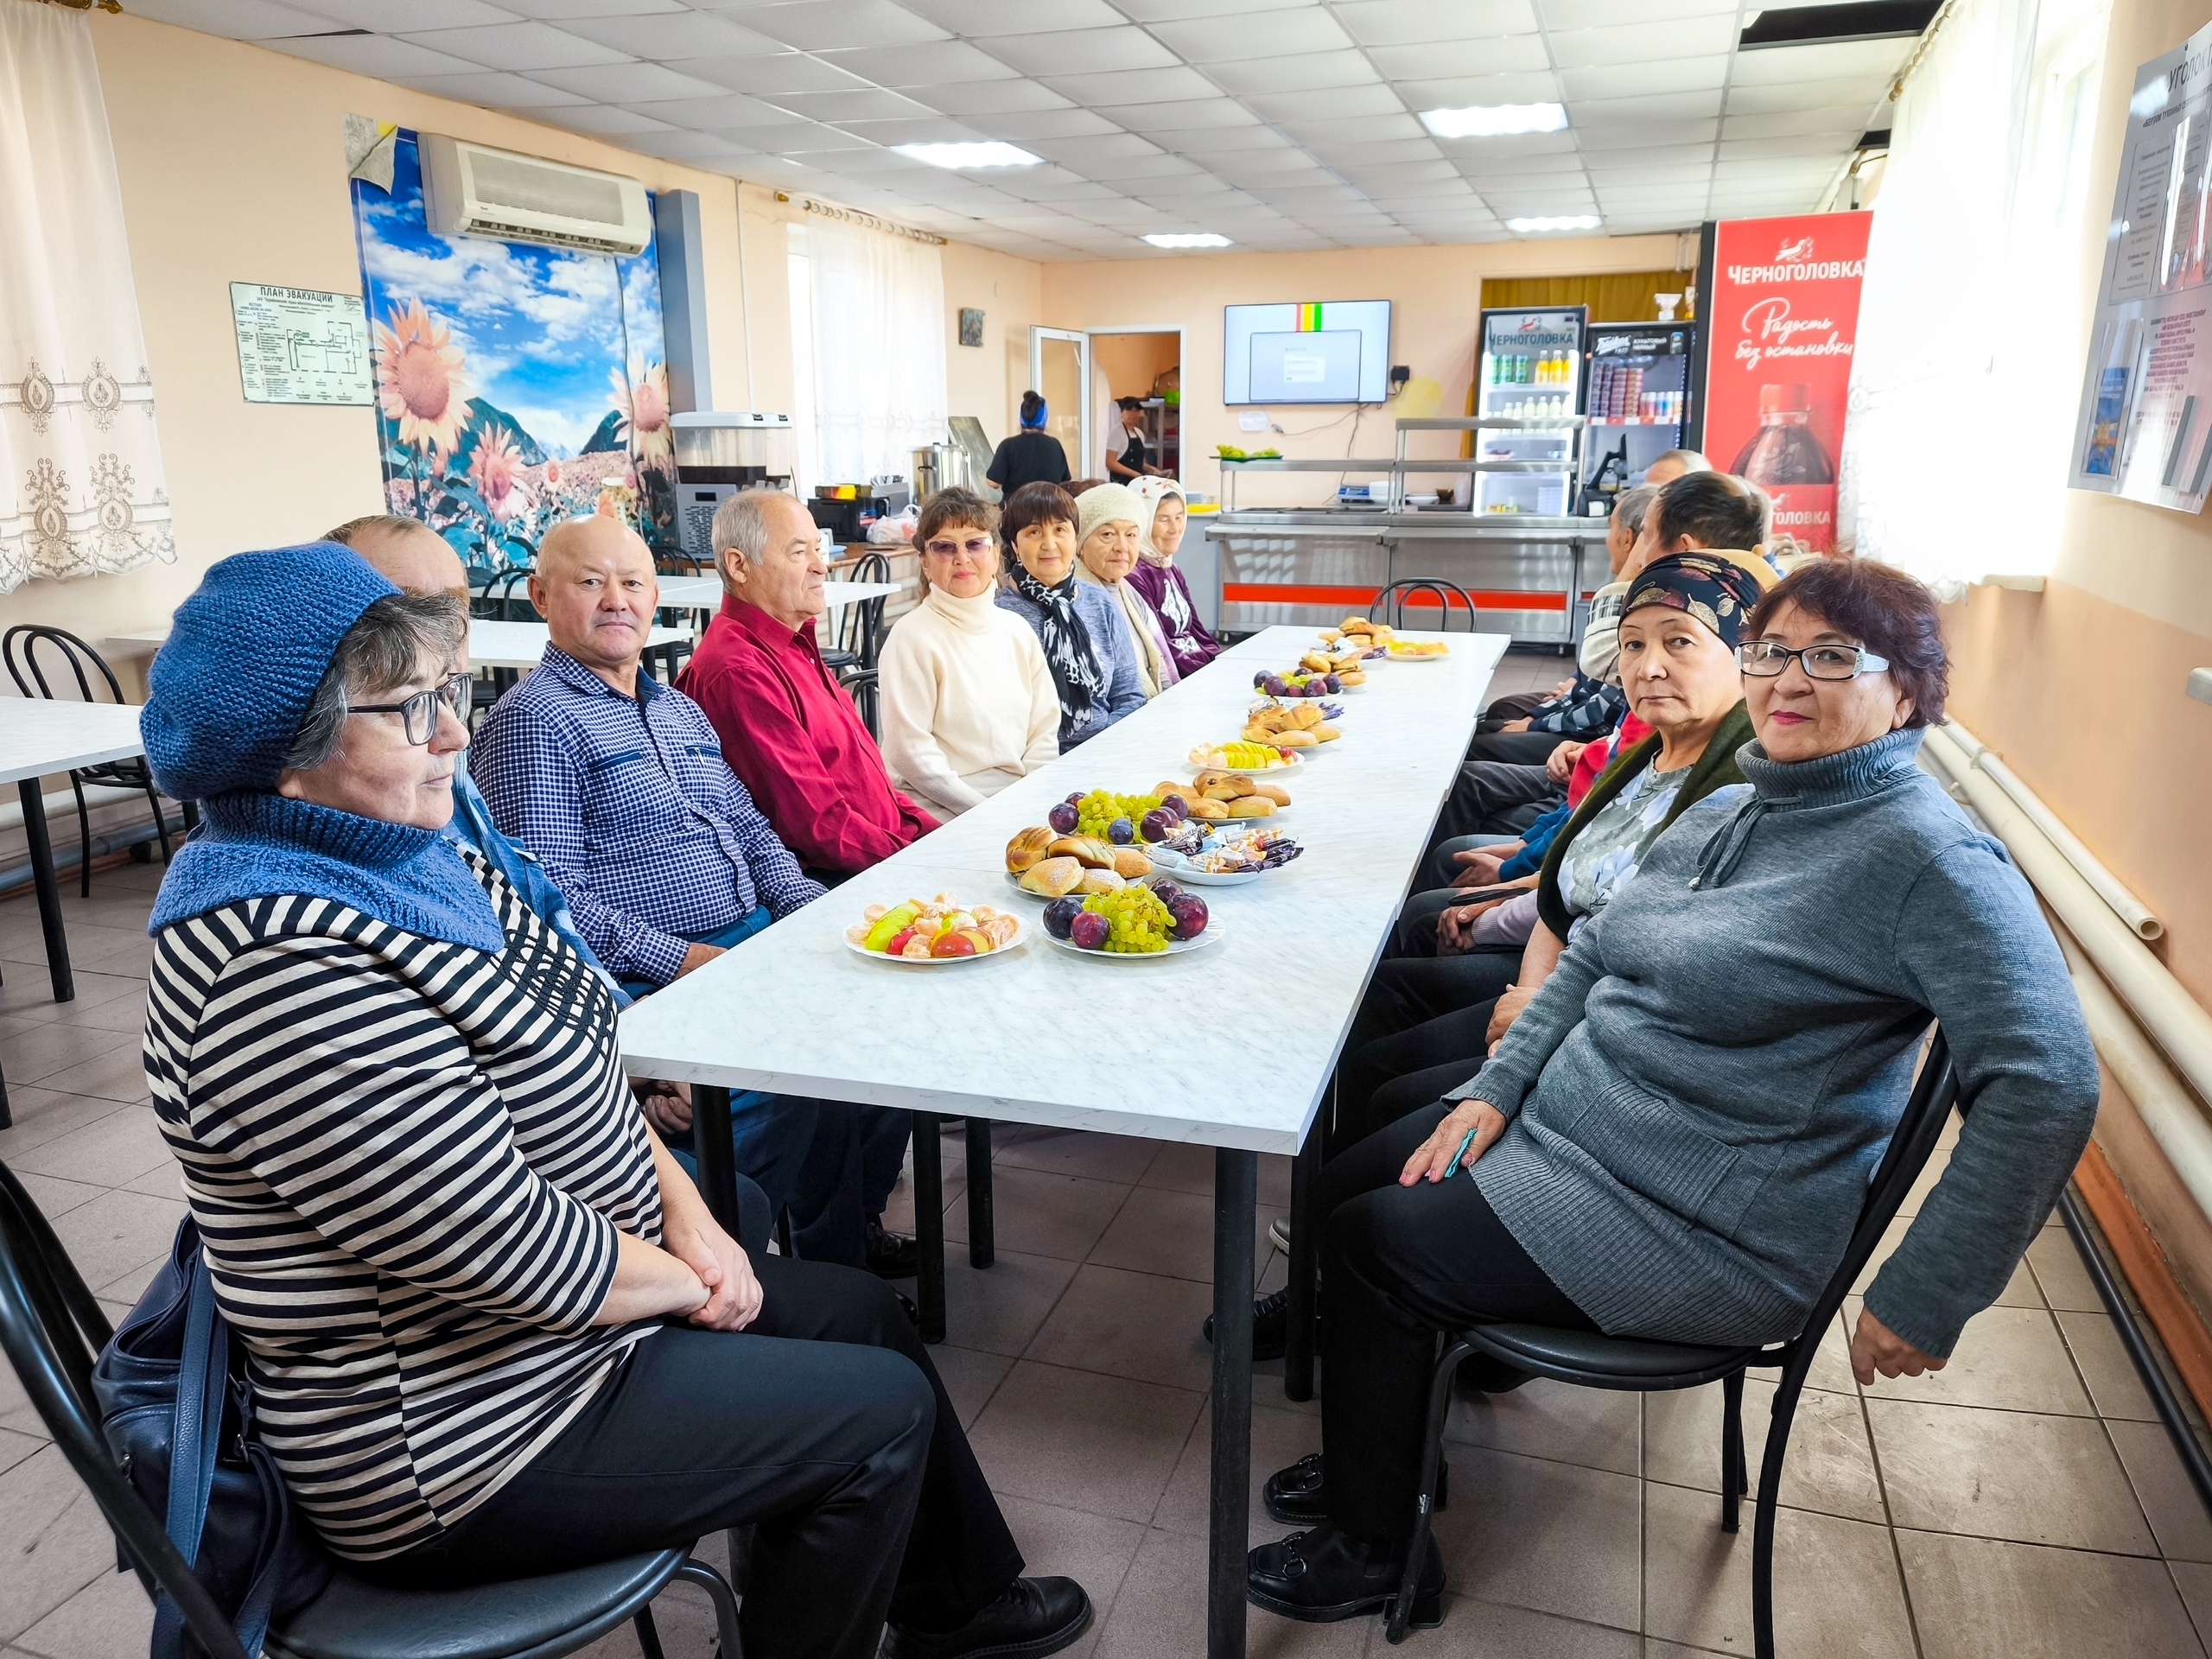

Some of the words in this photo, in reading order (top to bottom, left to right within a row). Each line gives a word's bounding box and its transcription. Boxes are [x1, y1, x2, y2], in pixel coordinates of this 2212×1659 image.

[2168, 48, 2207, 92] УГОЛОК
[1728, 259, 1864, 285] ЧЕРНОГОЛОВКА
[260, 286, 283, 297] ПЛАН
[286, 289, 333, 302] ЭВАКУАЦИИ
[1741, 296, 1834, 345] Радость
[1490, 333, 1573, 346] ЧЕРНОГОЛОВКА
[1734, 339, 1762, 372] без
[1764, 330, 1855, 359] остановки
